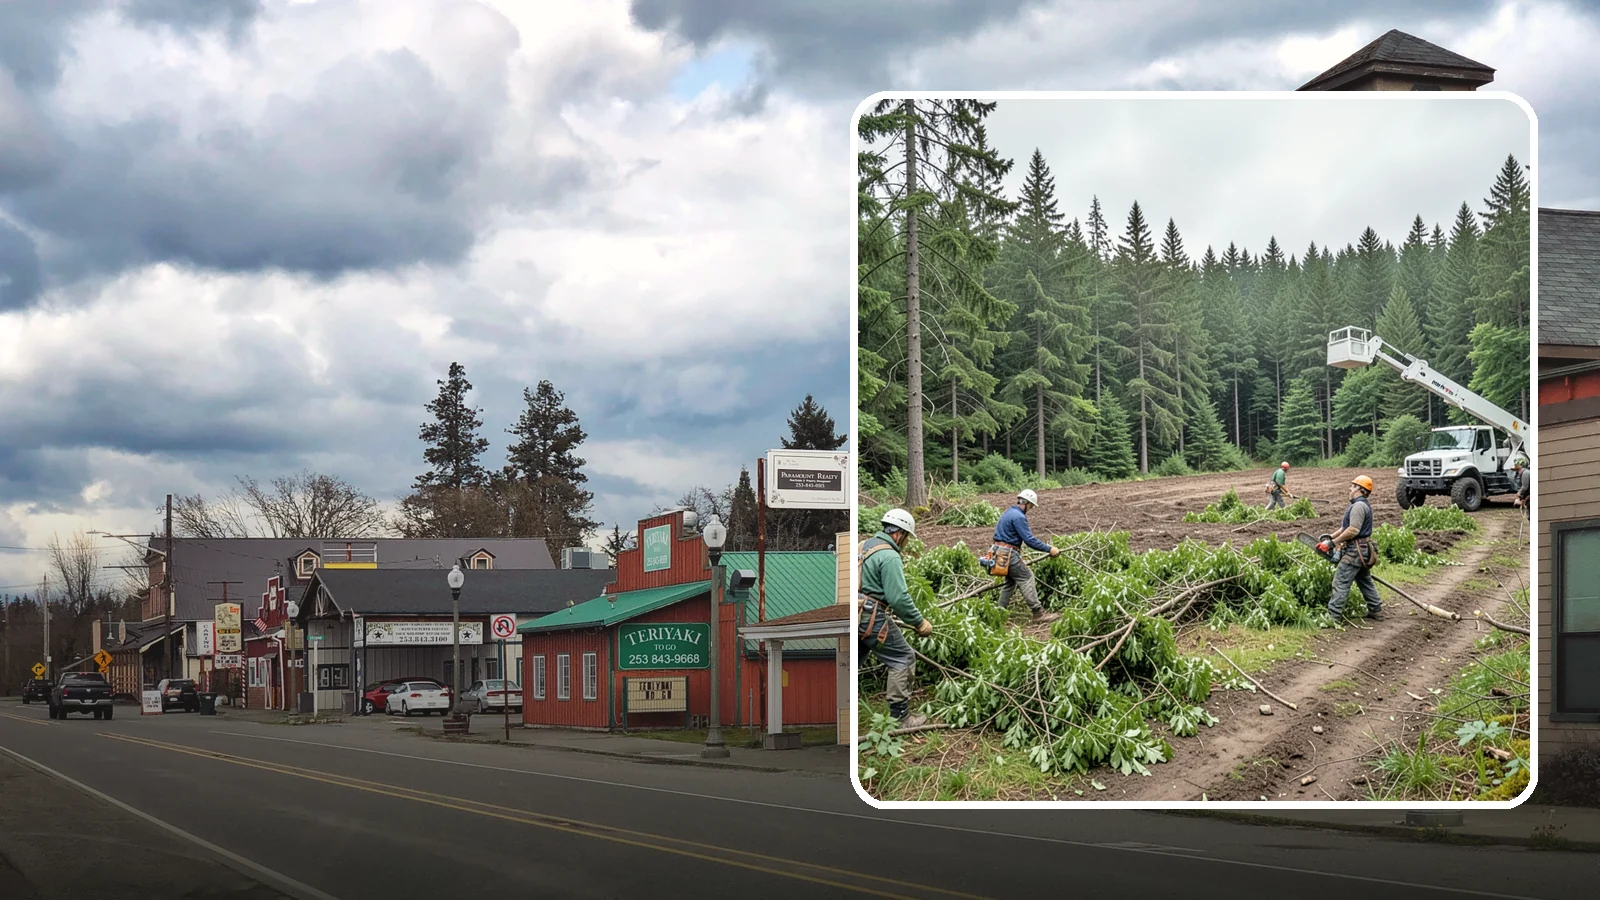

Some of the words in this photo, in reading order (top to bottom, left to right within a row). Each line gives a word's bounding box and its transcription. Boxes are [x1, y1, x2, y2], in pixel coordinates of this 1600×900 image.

[781, 471, 815, 479] PARAMOUNT
[817, 472, 839, 480] REALTY
[625, 627, 702, 646] TERIYAKI
[629, 654, 649, 665] 253
[651, 653, 700, 664] 843-9668
